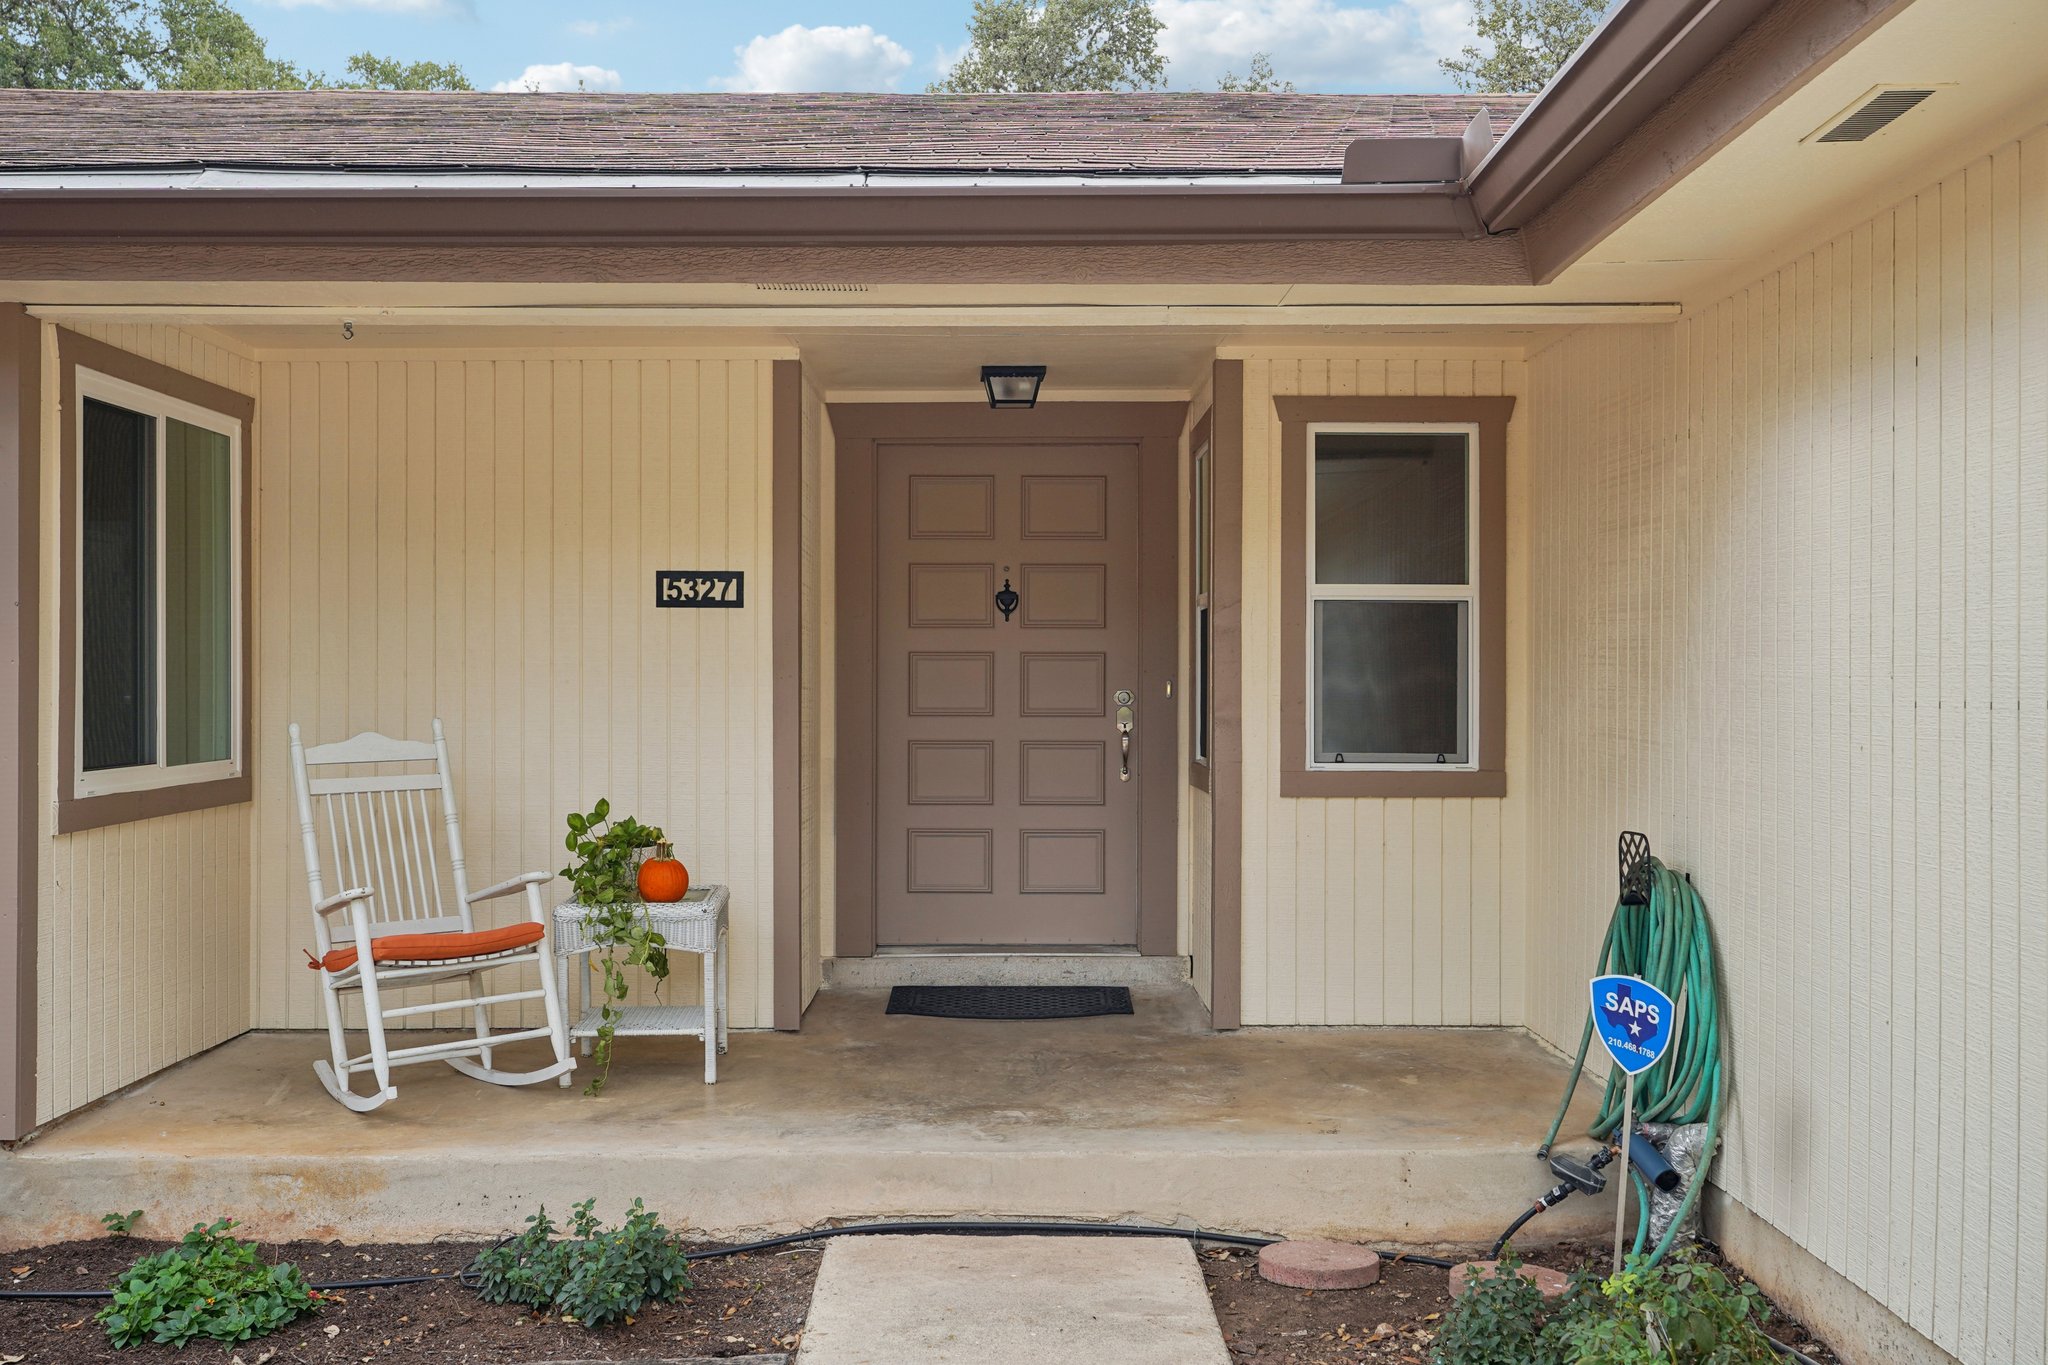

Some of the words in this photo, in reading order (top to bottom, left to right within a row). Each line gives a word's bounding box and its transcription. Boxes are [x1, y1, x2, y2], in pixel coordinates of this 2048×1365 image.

[666, 578, 733, 601] 5327
[1605, 992, 1660, 1025] SAPS
[1608, 1037, 1655, 1059] 210.468.1788
